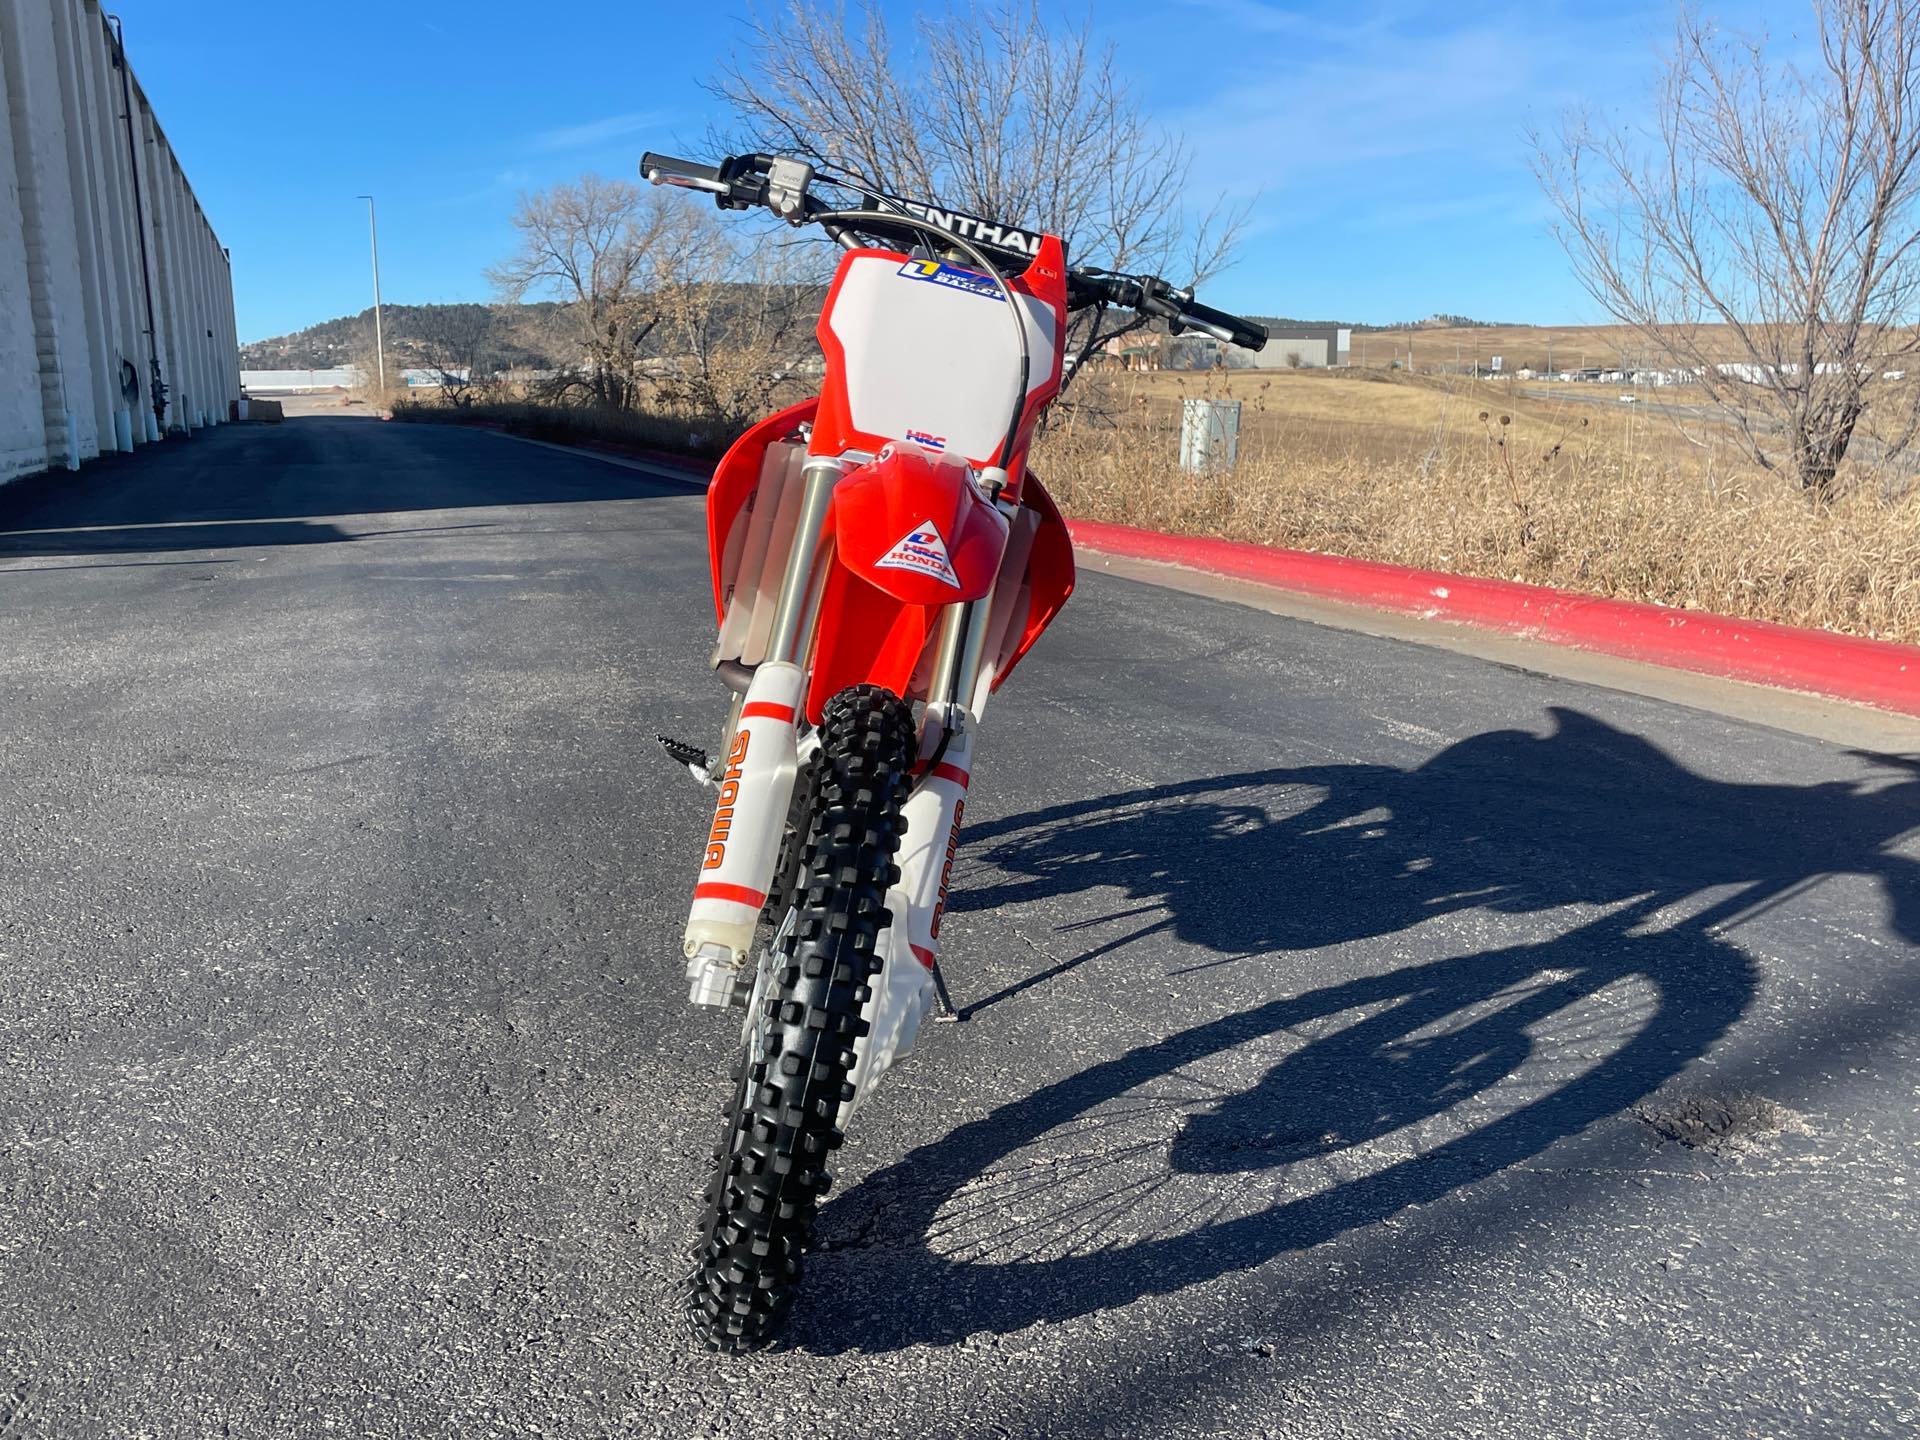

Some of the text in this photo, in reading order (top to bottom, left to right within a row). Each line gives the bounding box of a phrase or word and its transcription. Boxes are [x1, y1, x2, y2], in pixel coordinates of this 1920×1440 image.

[933, 275, 1004, 298] BAILEY
[906, 429, 946, 449] HRC
[890, 552, 952, 576] HONDA
[903, 543, 944, 562] HRC
[703, 729, 750, 870] SHOWA
